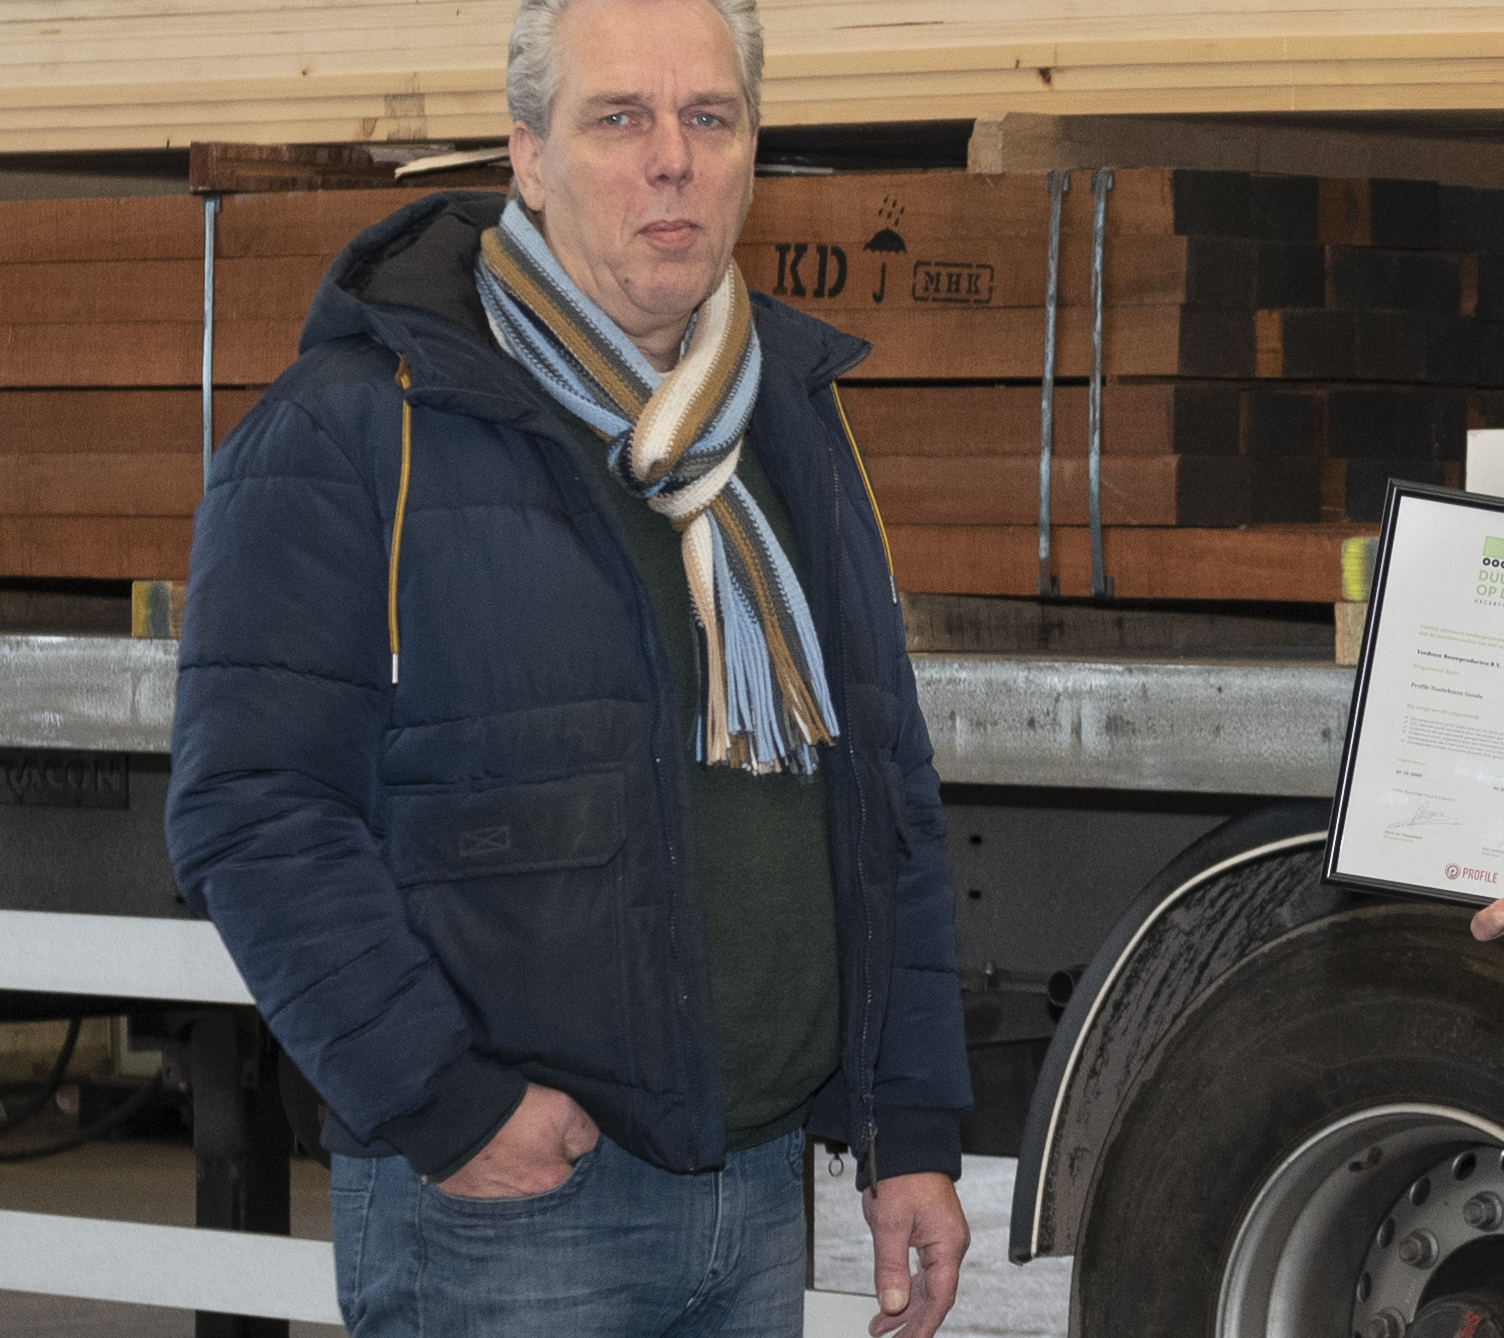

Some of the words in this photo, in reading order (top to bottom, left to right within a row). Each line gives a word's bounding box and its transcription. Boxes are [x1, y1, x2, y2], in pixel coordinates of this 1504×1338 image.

[772, 243, 848, 299] KD
[922, 270, 982, 297] MHK
[1476, 584, 1497, 597] OP
[1462, 867, 1499, 884] PROFILE
